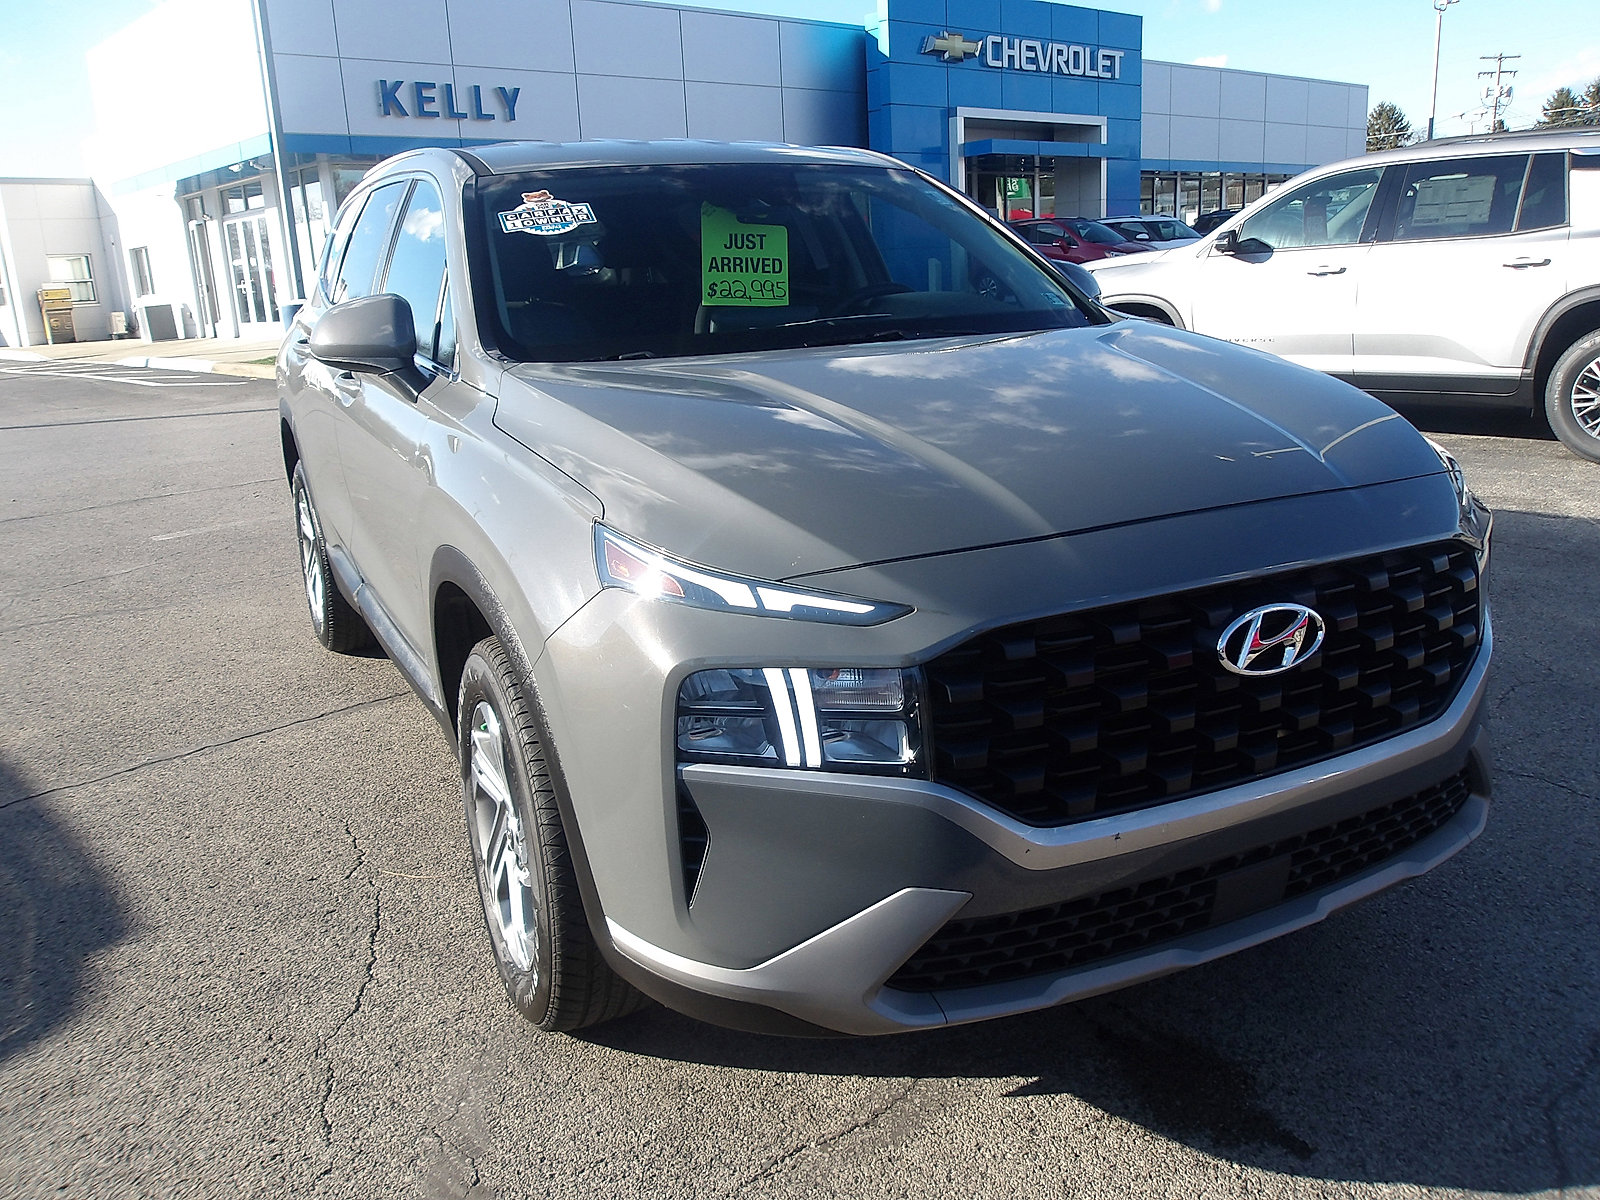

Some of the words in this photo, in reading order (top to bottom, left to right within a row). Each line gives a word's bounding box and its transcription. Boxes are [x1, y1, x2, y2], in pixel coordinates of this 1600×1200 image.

[986, 35, 1125, 79] CHEVROLET
[378, 79, 521, 121] KELLY
[505, 207, 585, 221] CARFAX
[723, 233, 767, 250] JUST
[707, 256, 783, 274] ARRIVED
[707, 279, 787, 302] $22,995
